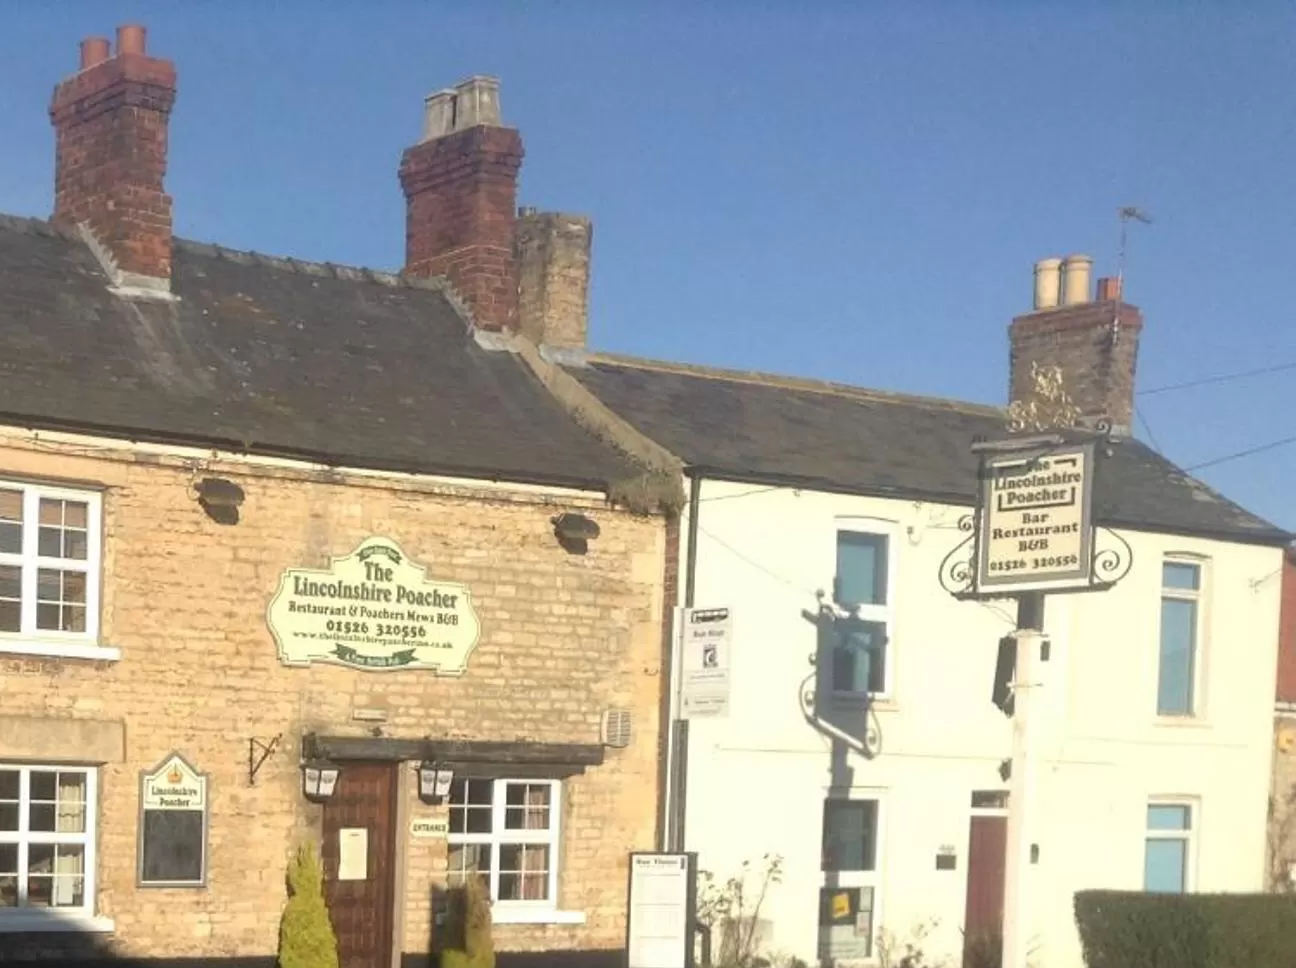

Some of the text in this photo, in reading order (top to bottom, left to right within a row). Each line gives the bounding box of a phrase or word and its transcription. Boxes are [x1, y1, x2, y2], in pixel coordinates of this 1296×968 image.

[994, 472, 1081, 491] Lincolnshire
[1006, 488, 1067, 505] Poacher
[1022, 512, 1049, 524] Bar
[992, 522, 1078, 540] Restaurant
[1018, 538, 1049, 552] B&B
[989, 554, 1078, 571] 01526 320556
[364, 561, 393, 582] The
[293, 575, 458, 609] Lincolnshire Poacher
[288, 600, 346, 616] Restaurant
[348, 604, 358, 617] &
[360, 605, 405, 621] Poachers
[436, 611, 459, 626] B&B
[326, 619, 426, 639] 01526 320556
[160, 796, 190, 807] Poacher
[413, 823, 446, 832] ENTRANCE
